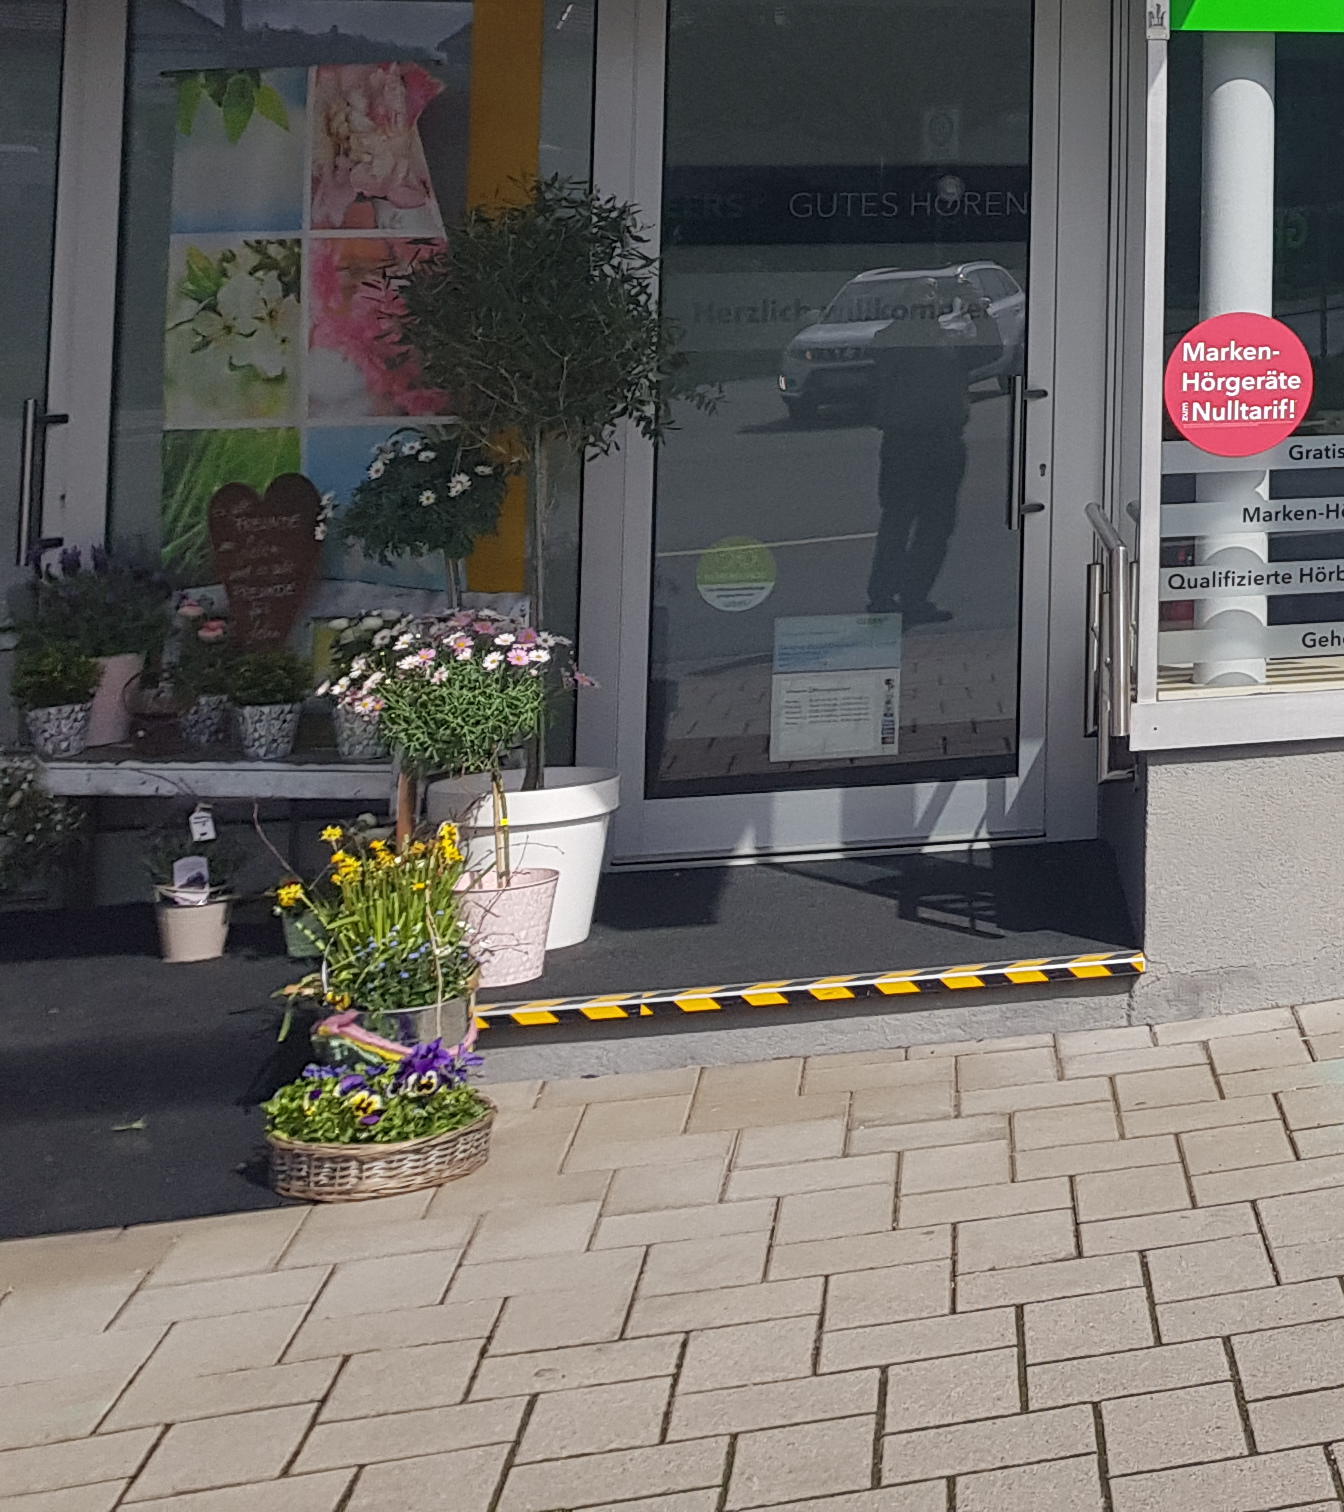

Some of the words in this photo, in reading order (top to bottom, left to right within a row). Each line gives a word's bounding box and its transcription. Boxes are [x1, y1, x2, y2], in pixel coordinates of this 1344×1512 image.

[789, 191, 899, 219] GUTES
[1182, 340, 1280, 363] Marken-
[1182, 370, 1301, 397] Hörgeräte
[1168, 570, 1293, 591] Qualifizierte
